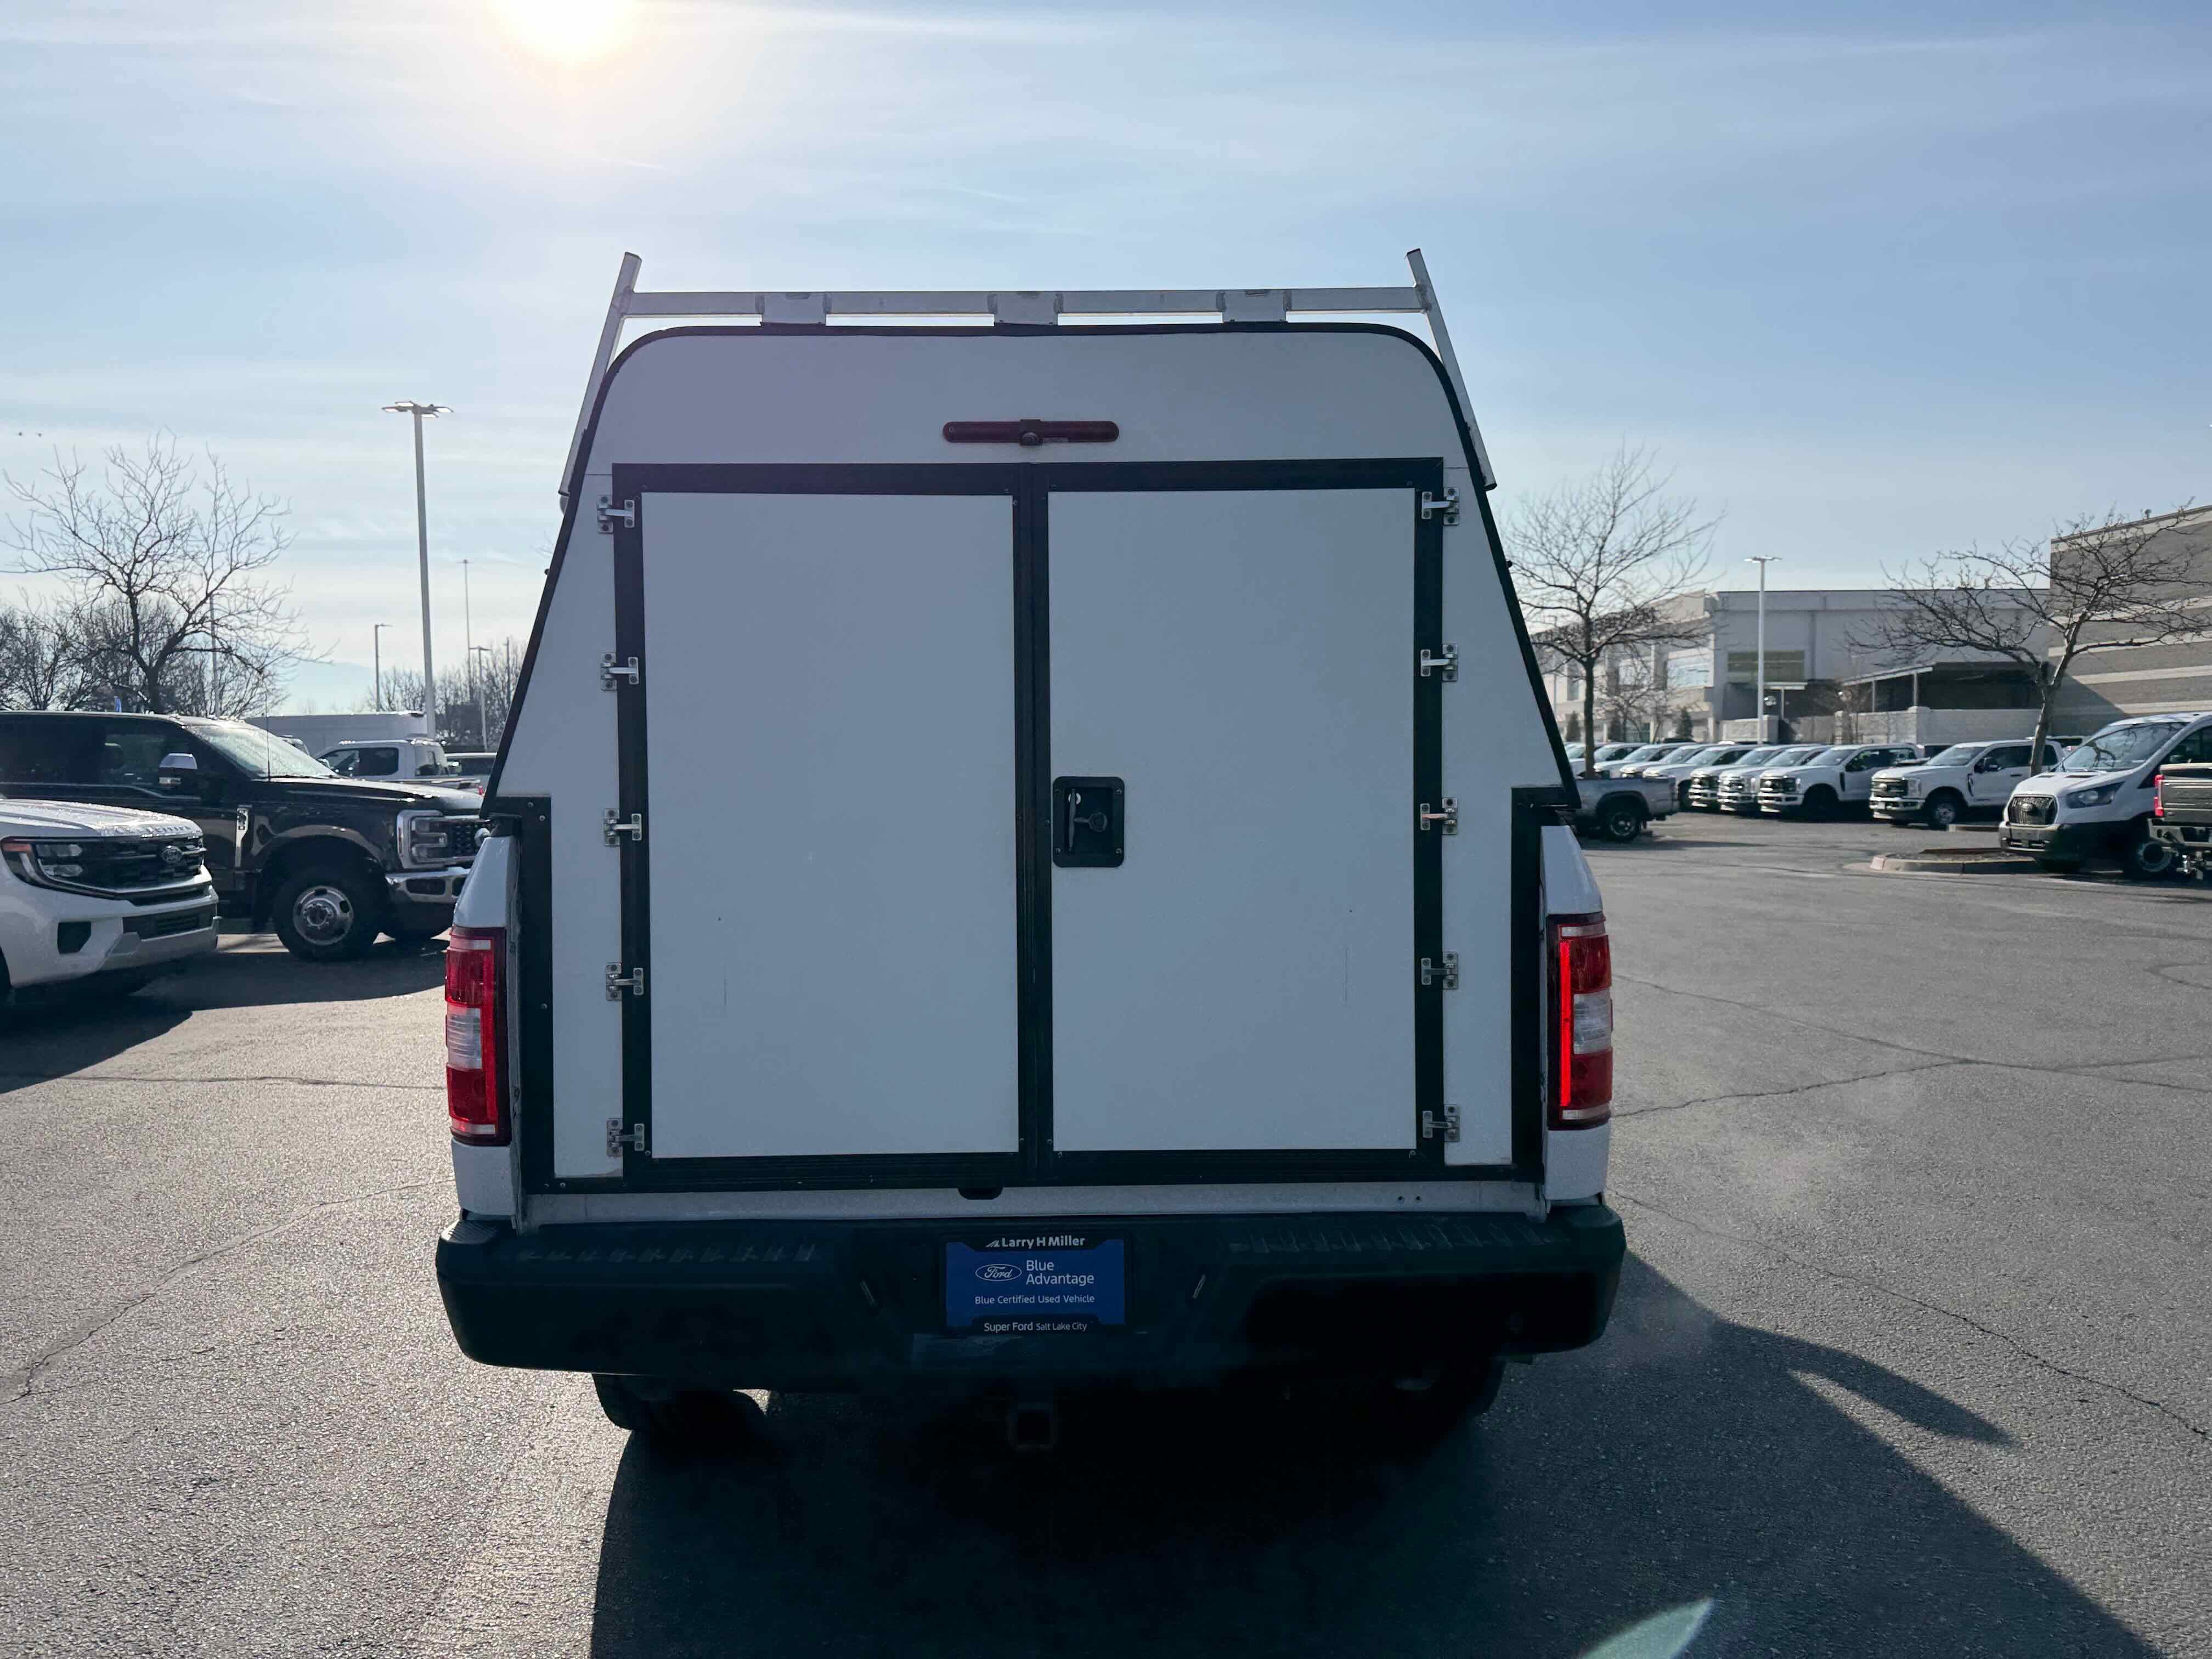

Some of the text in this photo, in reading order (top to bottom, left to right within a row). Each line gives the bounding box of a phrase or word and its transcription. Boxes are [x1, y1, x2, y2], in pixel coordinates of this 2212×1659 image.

[1002, 1235, 1086, 1249] Larry H Miller
[1026, 1260, 1054, 1271] Blue
[984, 1266, 1013, 1278] Ford
[1026, 1273, 1094, 1286] Advantage
[997, 1295, 1035, 1304] Certified
[1063, 1295, 1095, 1303] Vehicle
[984, 1323, 1011, 1333] Super
[1012, 1322, 1033, 1330] Ford
[1072, 1322, 1087, 1331] City
